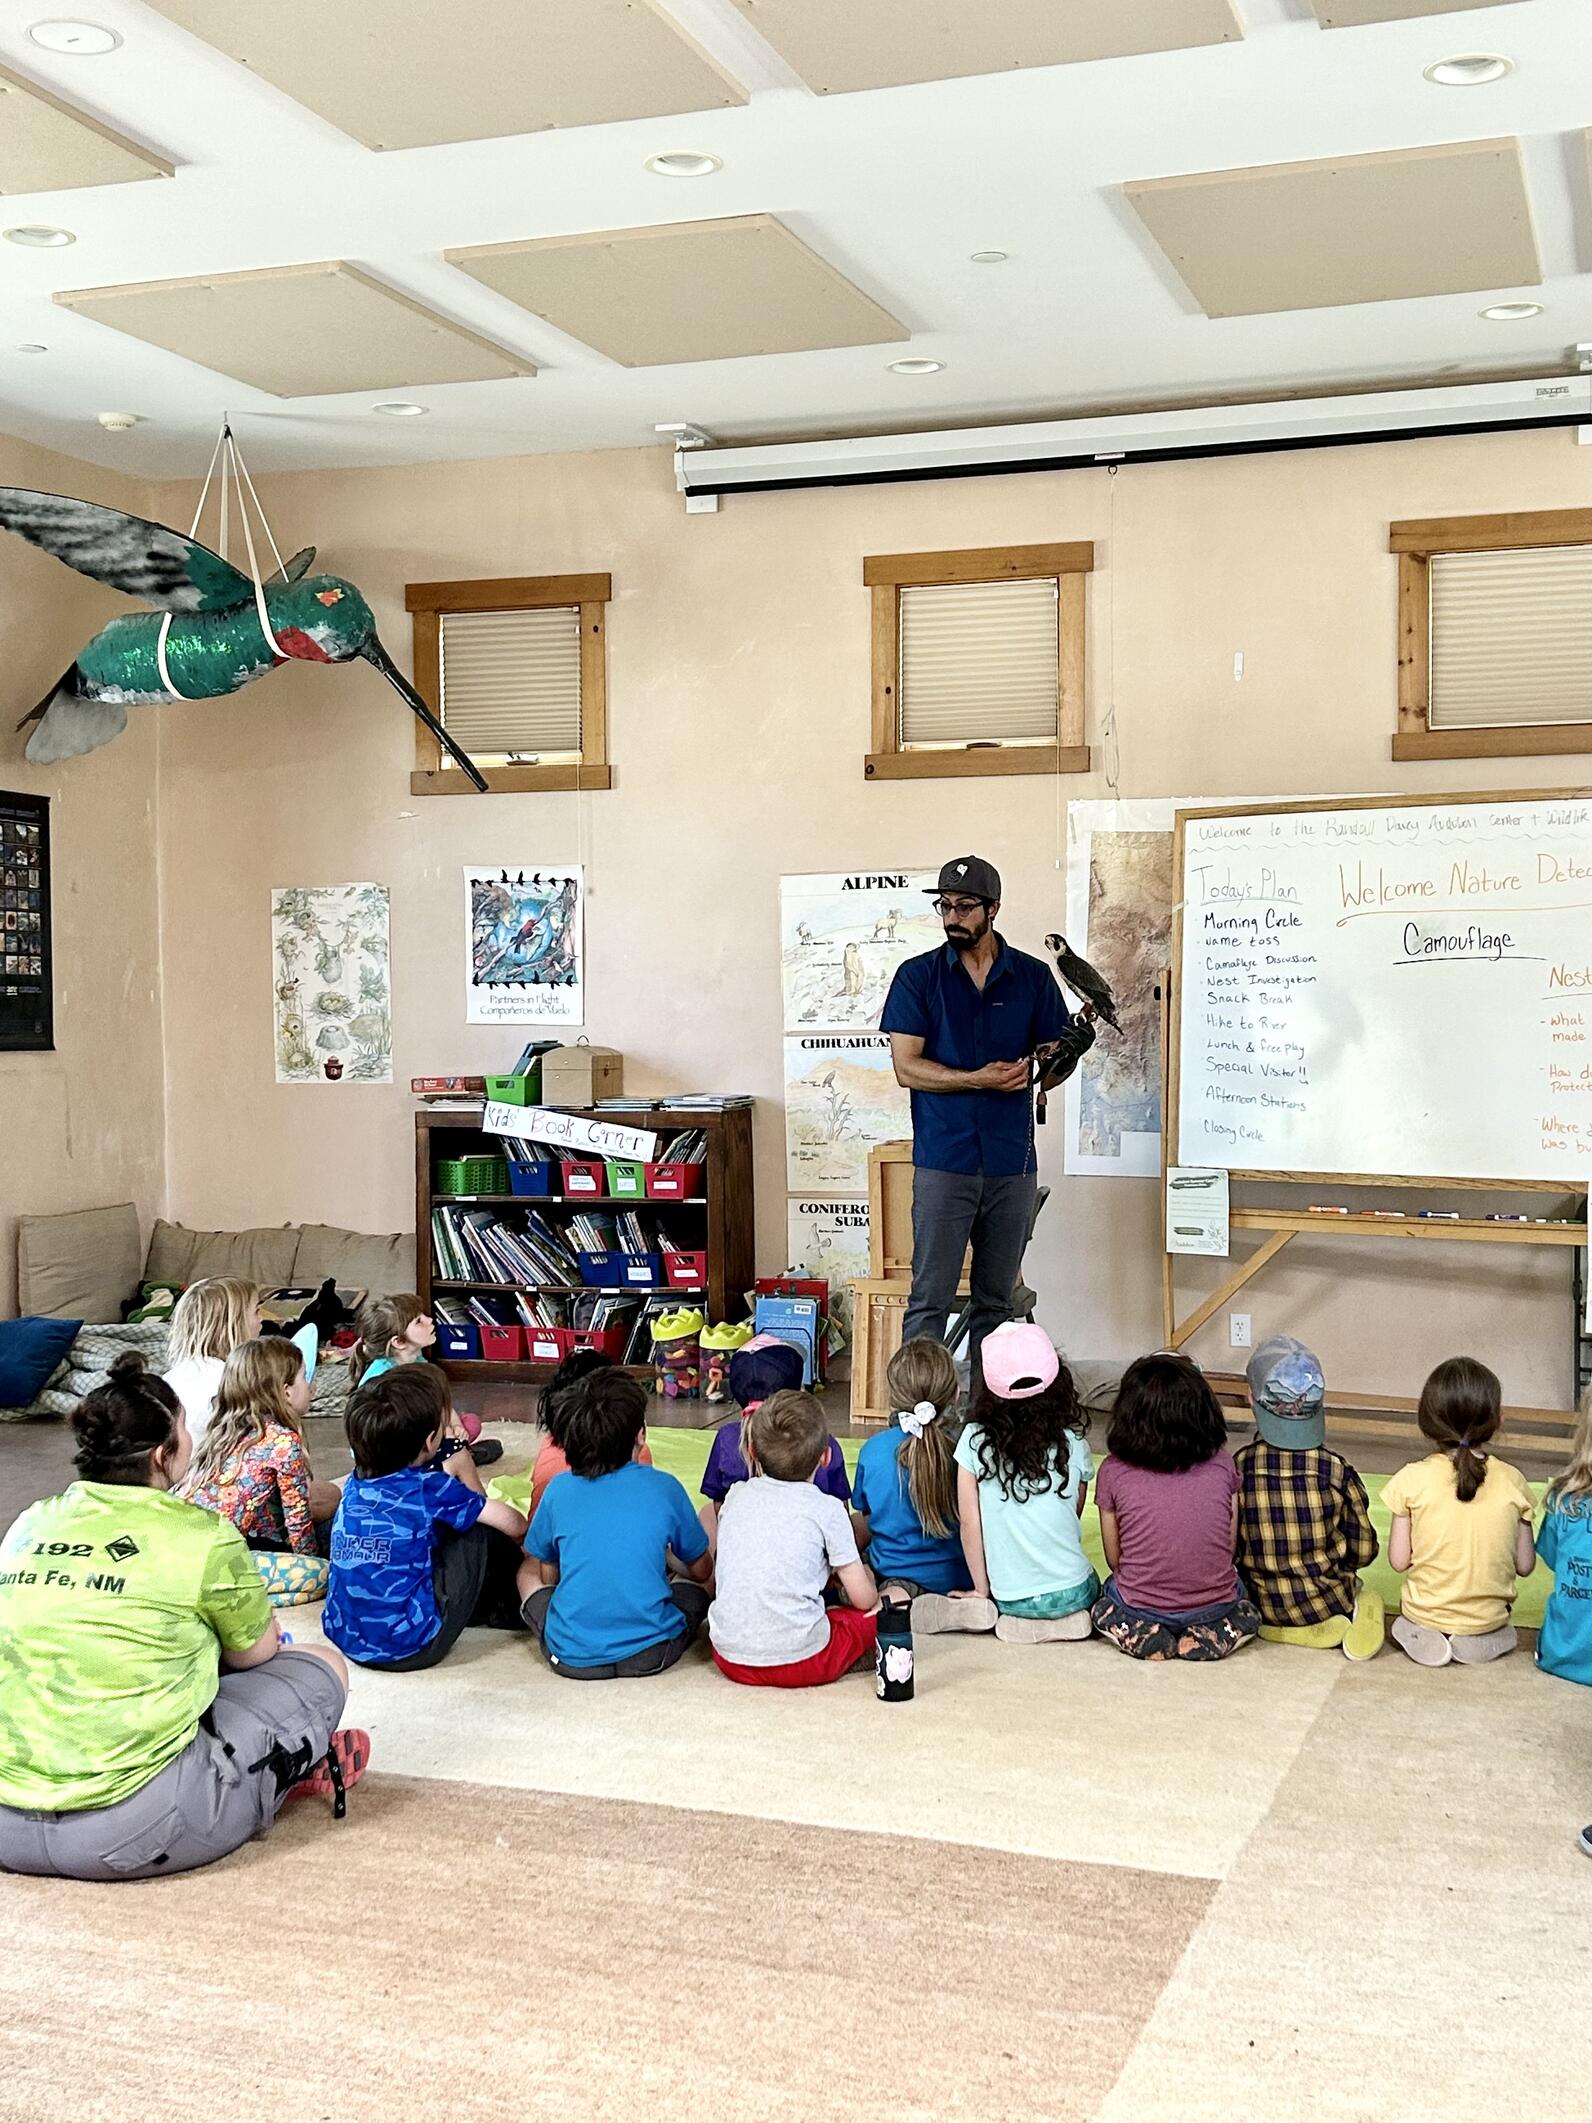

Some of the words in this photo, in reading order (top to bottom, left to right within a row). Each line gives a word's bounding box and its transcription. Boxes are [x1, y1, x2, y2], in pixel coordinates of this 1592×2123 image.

[1200, 825, 1252, 840] Welcome
[1270, 821, 1281, 836] to
[841, 875, 909, 890] ALPINE
[1261, 867, 1298, 900] Plan
[1339, 860, 1437, 908] Welcome
[1449, 860, 1522, 895] Nature
[1204, 912, 1258, 934] Morning
[1265, 908, 1303, 929] Circle
[1250, 936, 1280, 947] toss
[1403, 922, 1516, 961] Camouflage
[1266, 954, 1318, 965] Discussion
[1207, 976, 1240, 986] Nest
[1248, 974, 1317, 989] Investigation
[1207, 991, 1250, 1005] Snack
[1259, 992, 1293, 1005] Break
[1206, 1013, 1233, 1029] Hike
[1240, 1015, 1254, 1030] to
[1207, 1039, 1240, 1051] Lunch
[1246, 1041, 1255, 1053] &
[1552, 1032, 1586, 1042] made
[1206, 1056, 1253, 1076] Special
[1550, 1063, 1571, 1078] How
[1206, 1085, 1257, 1104] Afternoon
[530, 1110, 575, 1138] Book
[588, 1121, 645, 1150] Corner
[1204, 1120, 1236, 1144] Closing
[1541, 1115, 1579, 1134] Where
[31, 1542, 95, 1557] 192
[1567, 1561, 1592, 1579] POST
[0, 1569, 37, 1585] anta
[44, 1569, 77, 1591] Fe,
[85, 1571, 126, 1595] NM
[1561, 1582, 1592, 1600] PARCE
